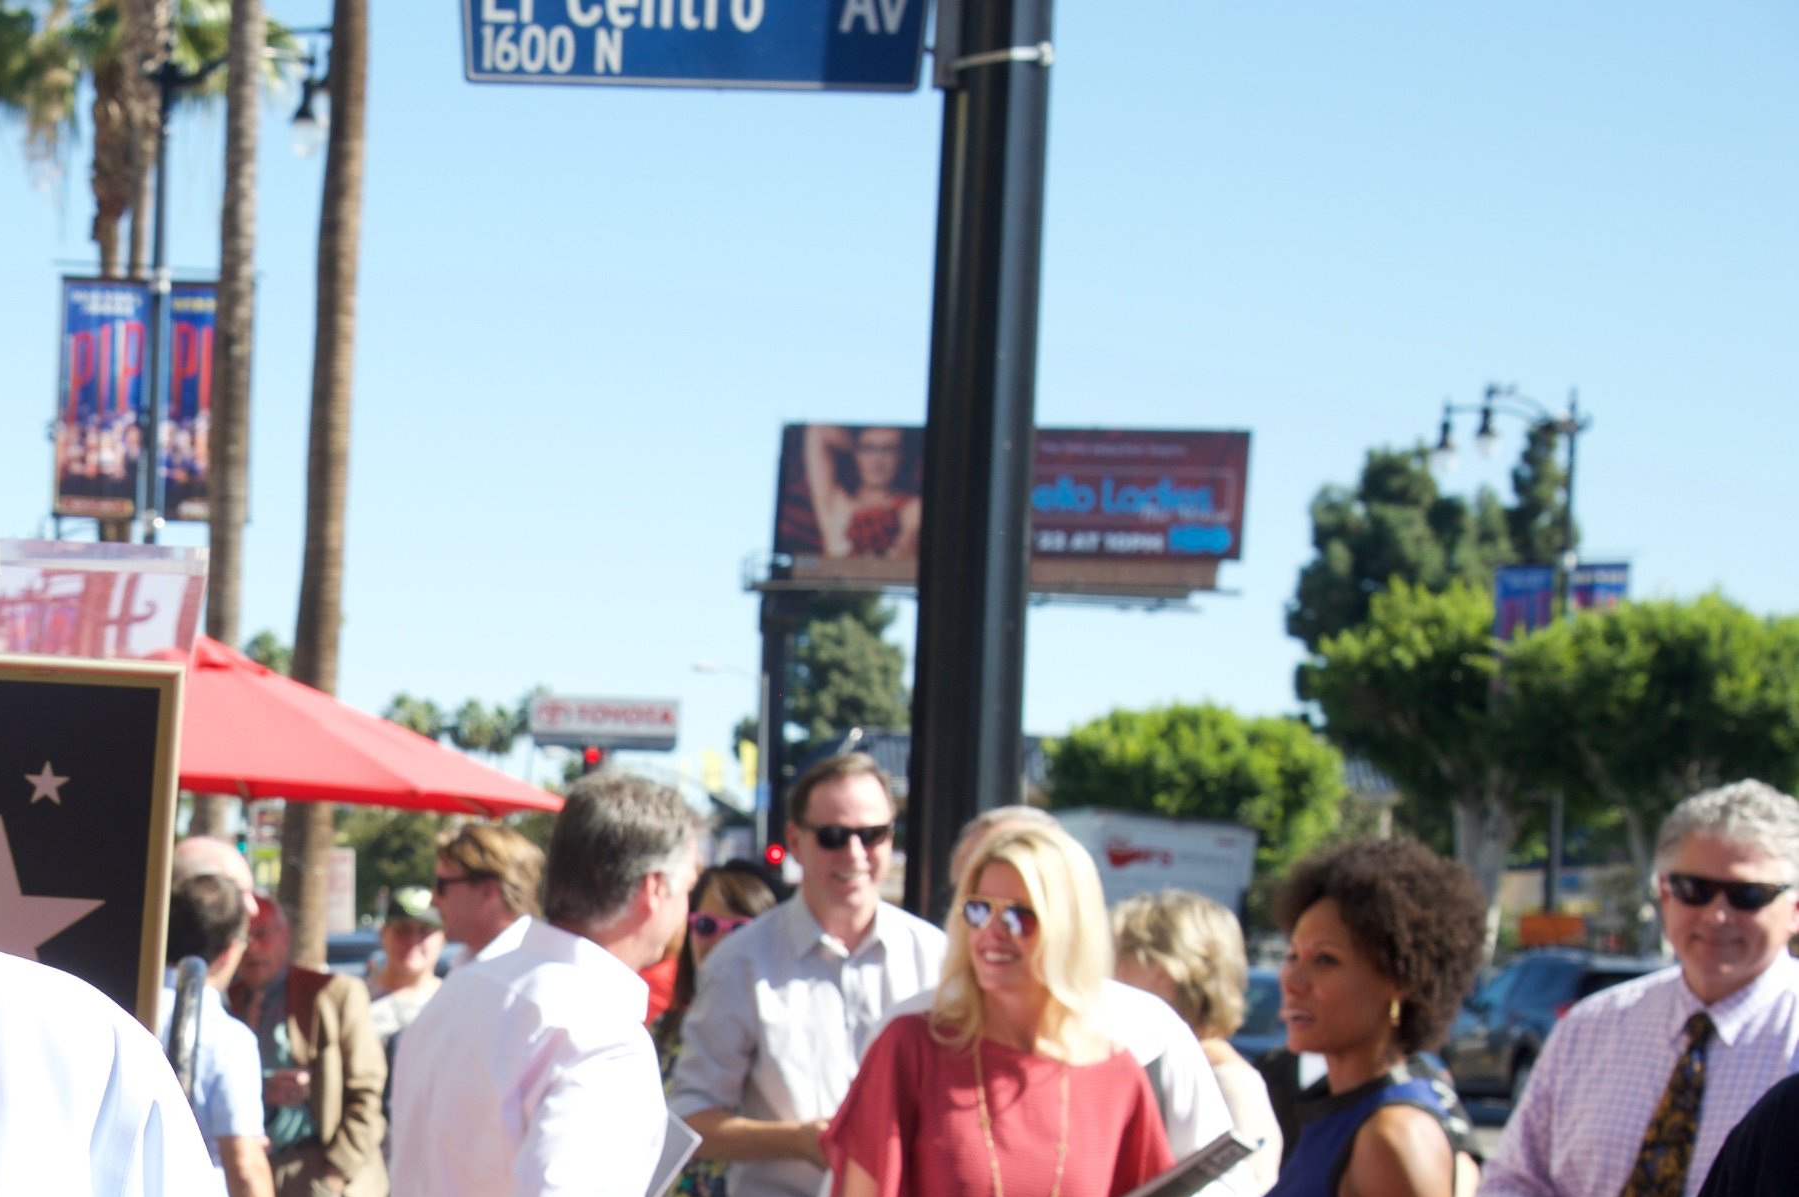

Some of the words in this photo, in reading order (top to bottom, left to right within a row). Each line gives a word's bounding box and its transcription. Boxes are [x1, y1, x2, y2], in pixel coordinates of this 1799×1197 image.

[481, 24, 576, 74] 1600
[594, 27, 622, 74] N
[578, 704, 675, 724] TOYOTA
